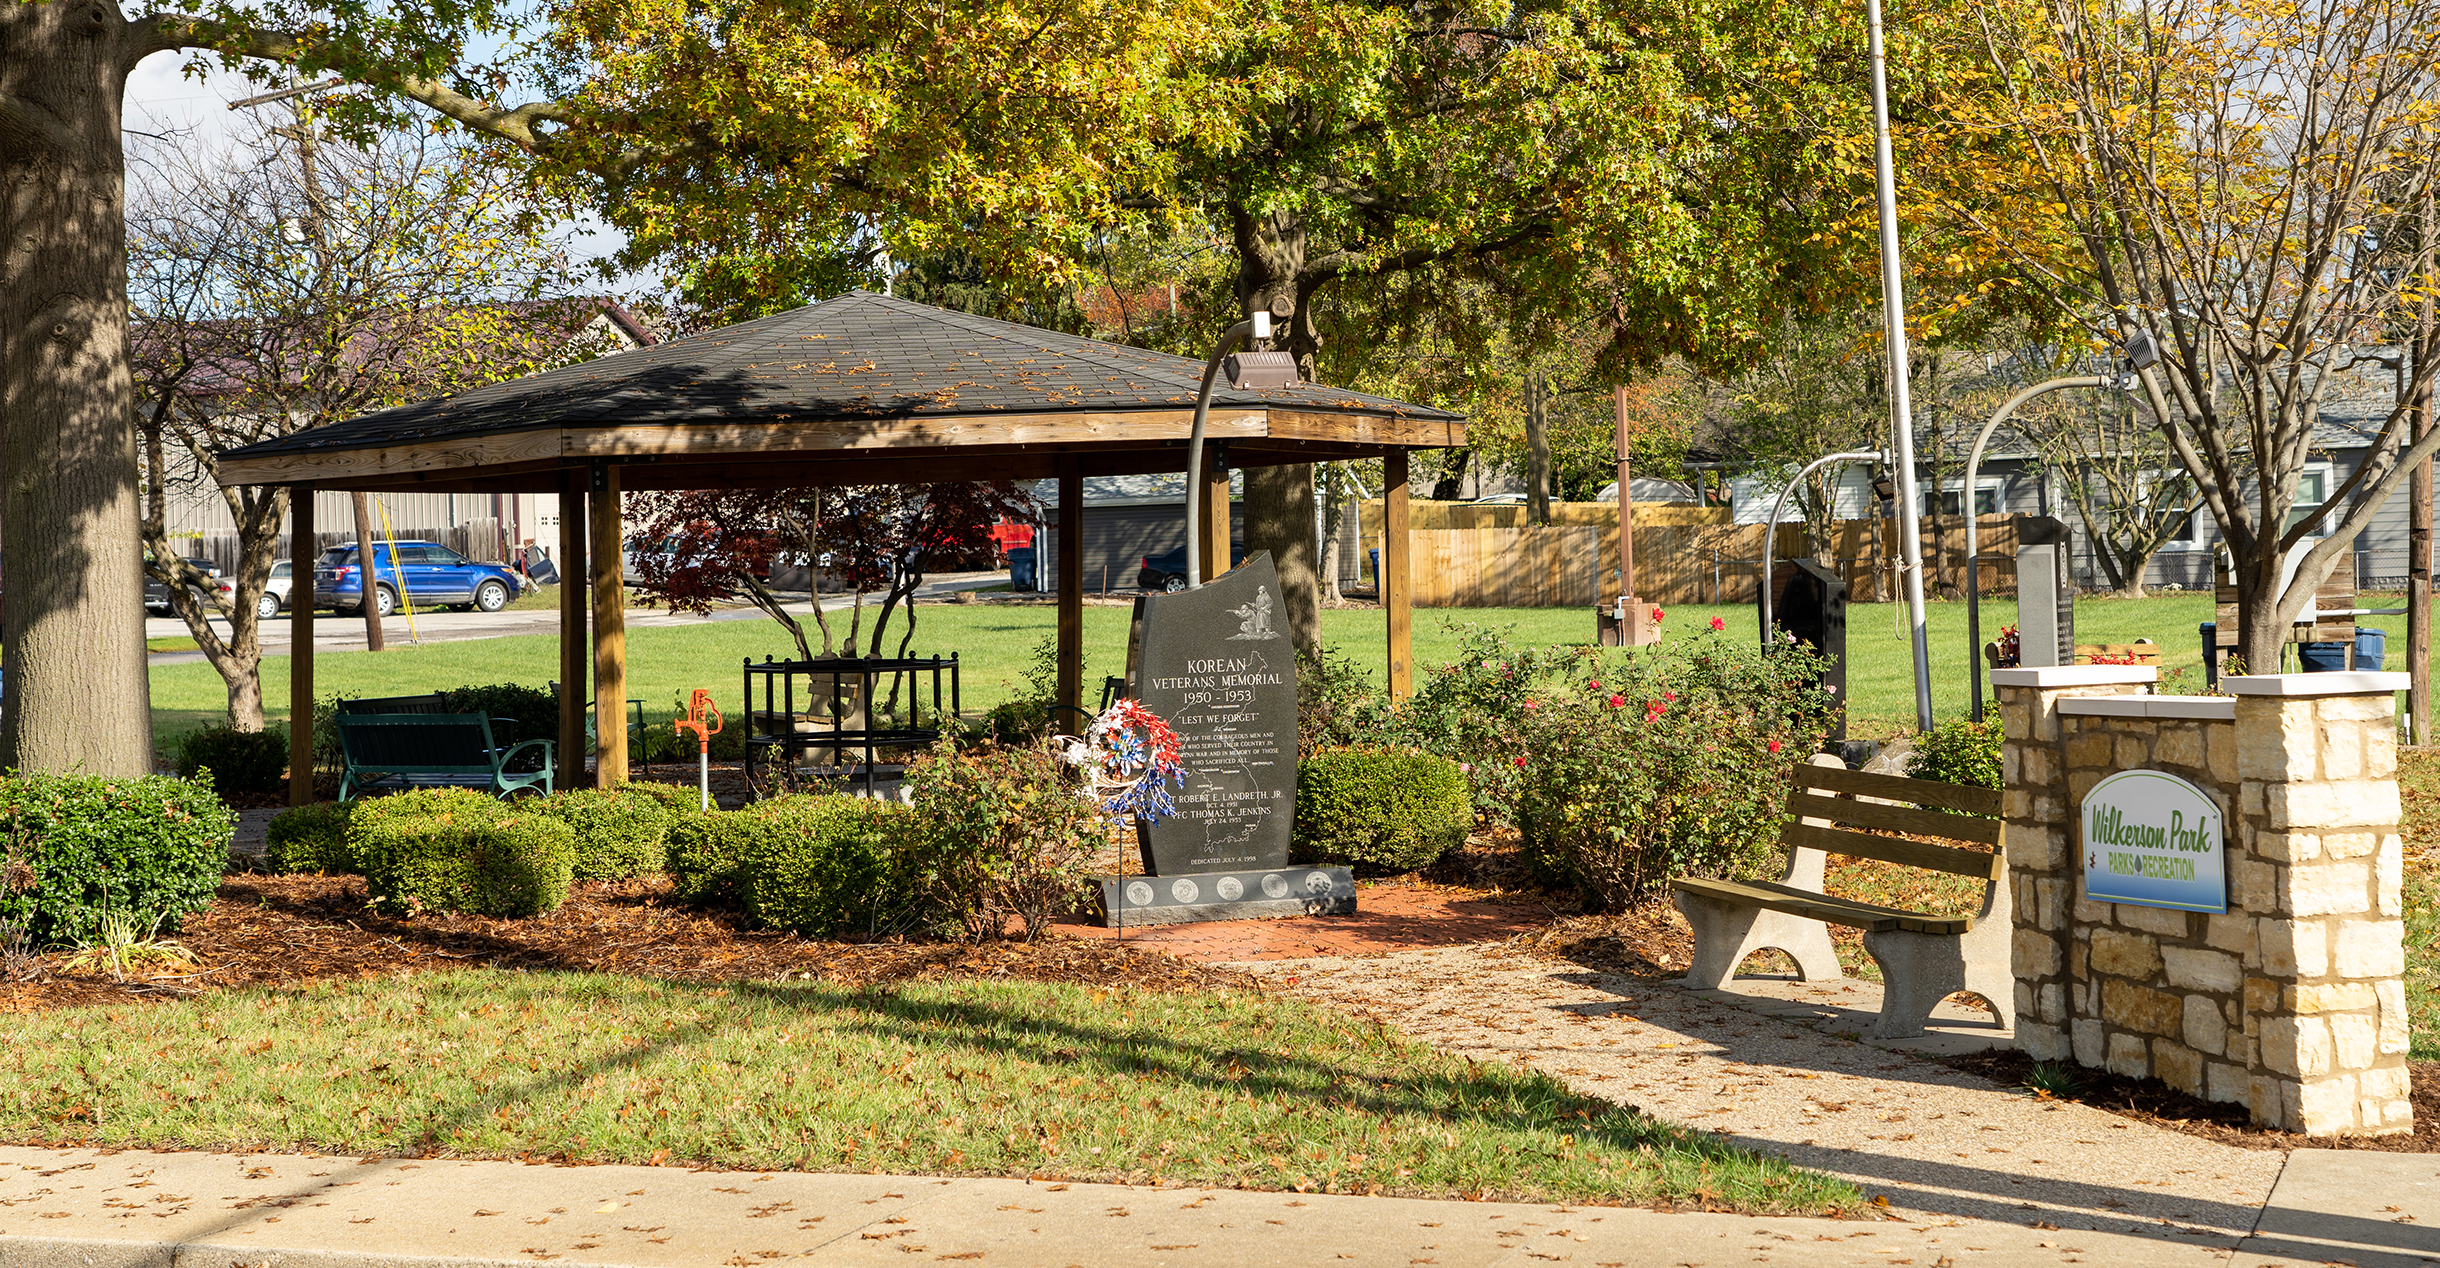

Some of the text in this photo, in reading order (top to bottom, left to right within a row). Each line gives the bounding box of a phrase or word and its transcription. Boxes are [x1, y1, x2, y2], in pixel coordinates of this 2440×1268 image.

[1188, 658, 1246, 674] KOREAN
[1152, 674, 1283, 690] VETERANS MEMORIAL
[1184, 691, 1212, 703] 1950
[1225, 690, 1252, 702] 1953
[1206, 714, 1220, 723] WE
[1213, 732, 1249, 741] COURAGEOUS
[1187, 742, 1200, 750] WHO
[1229, 748, 1252, 756] MEMORY
[1179, 793, 1210, 804] ROBERT
[1213, 793, 1221, 802] E.
[1271, 790, 1284, 799] JR.
[1190, 808, 1225, 819] THOMAS
[1228, 808, 1235, 817] K.
[1237, 806, 1272, 816] JENKINS
[2092, 803, 2212, 853] Wilkerson Park
[1190, 857, 1221, 865] DEDICATED
[2108, 851, 2195, 882] PARKS RECREATION
